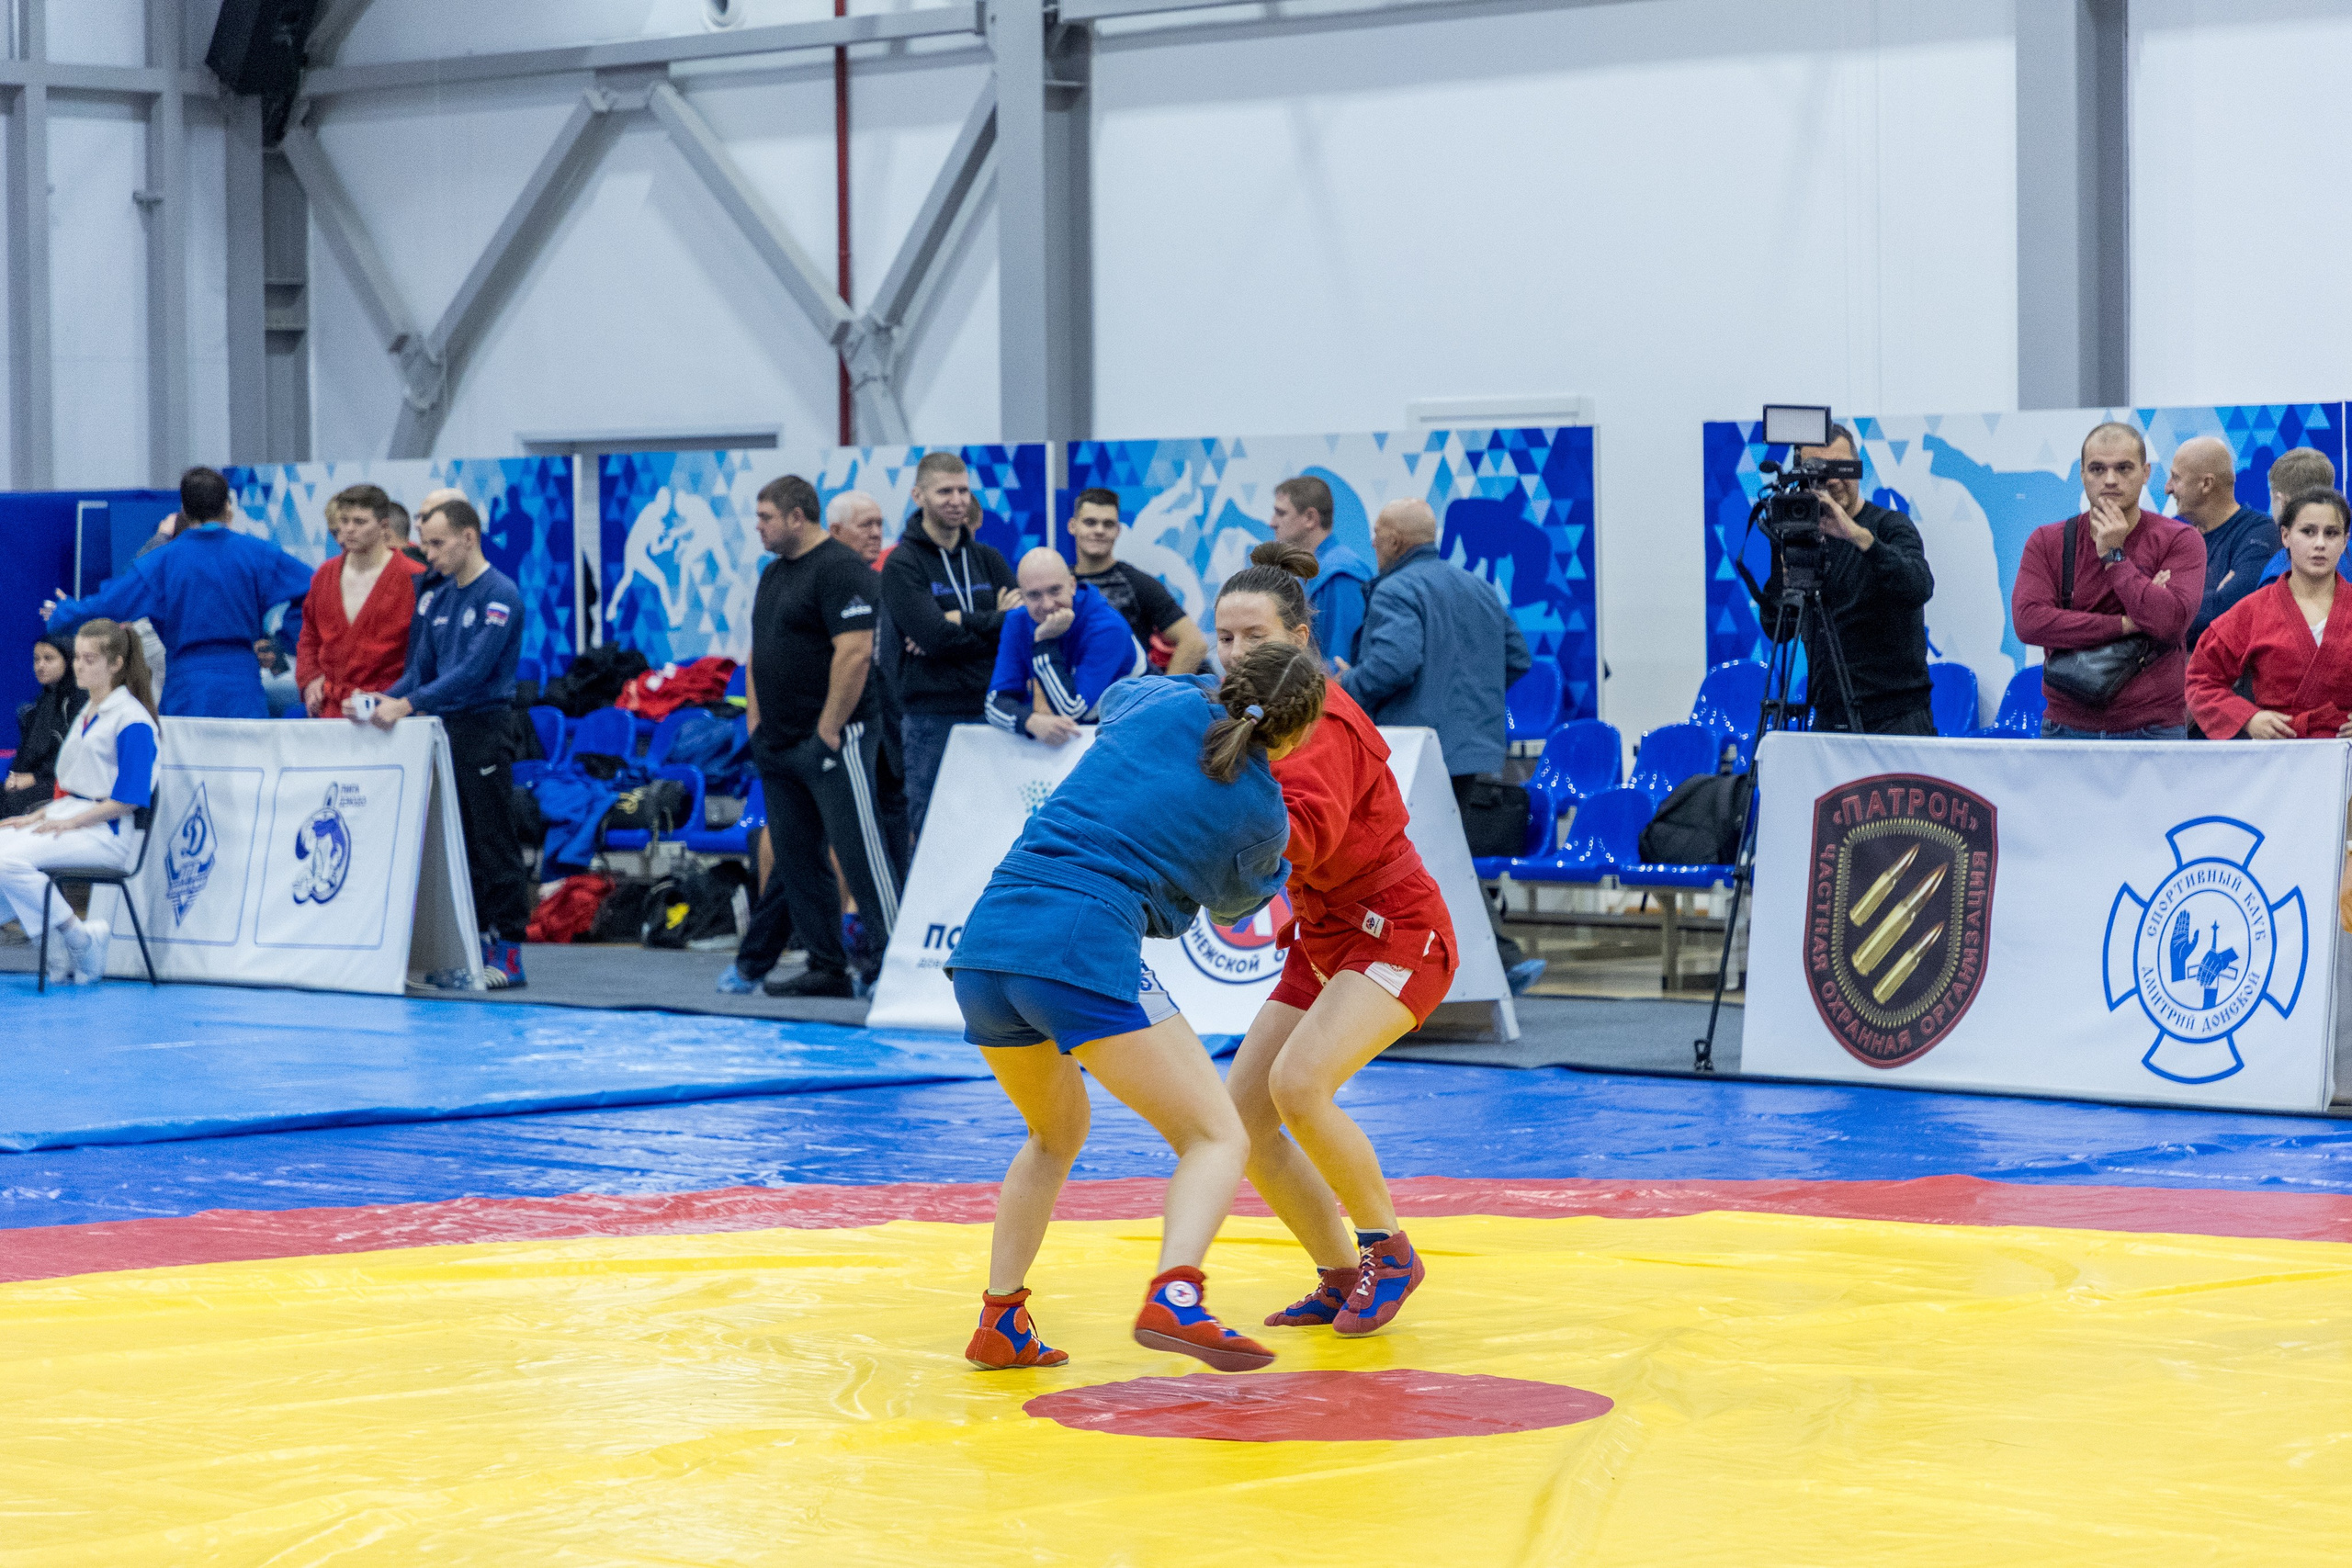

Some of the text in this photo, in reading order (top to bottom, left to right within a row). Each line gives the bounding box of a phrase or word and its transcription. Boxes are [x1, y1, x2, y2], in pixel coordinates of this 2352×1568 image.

[1833, 788, 1978, 830] «ПАТРОН»
[2147, 869, 2267, 941] СПОРТИВНЫЙ КЛУБ
[923, 923, 963, 951] ПО
[1189, 917, 1261, 974] ОНЕЖСКОЙ
[1813, 843, 1988, 1055] ЧАСТНАЯ ОХРАННАЯ ОРГАНИЗАЦИЯ
[2142, 965, 2260, 1032] ДМИТРИЙ ДОНСКОЙ
